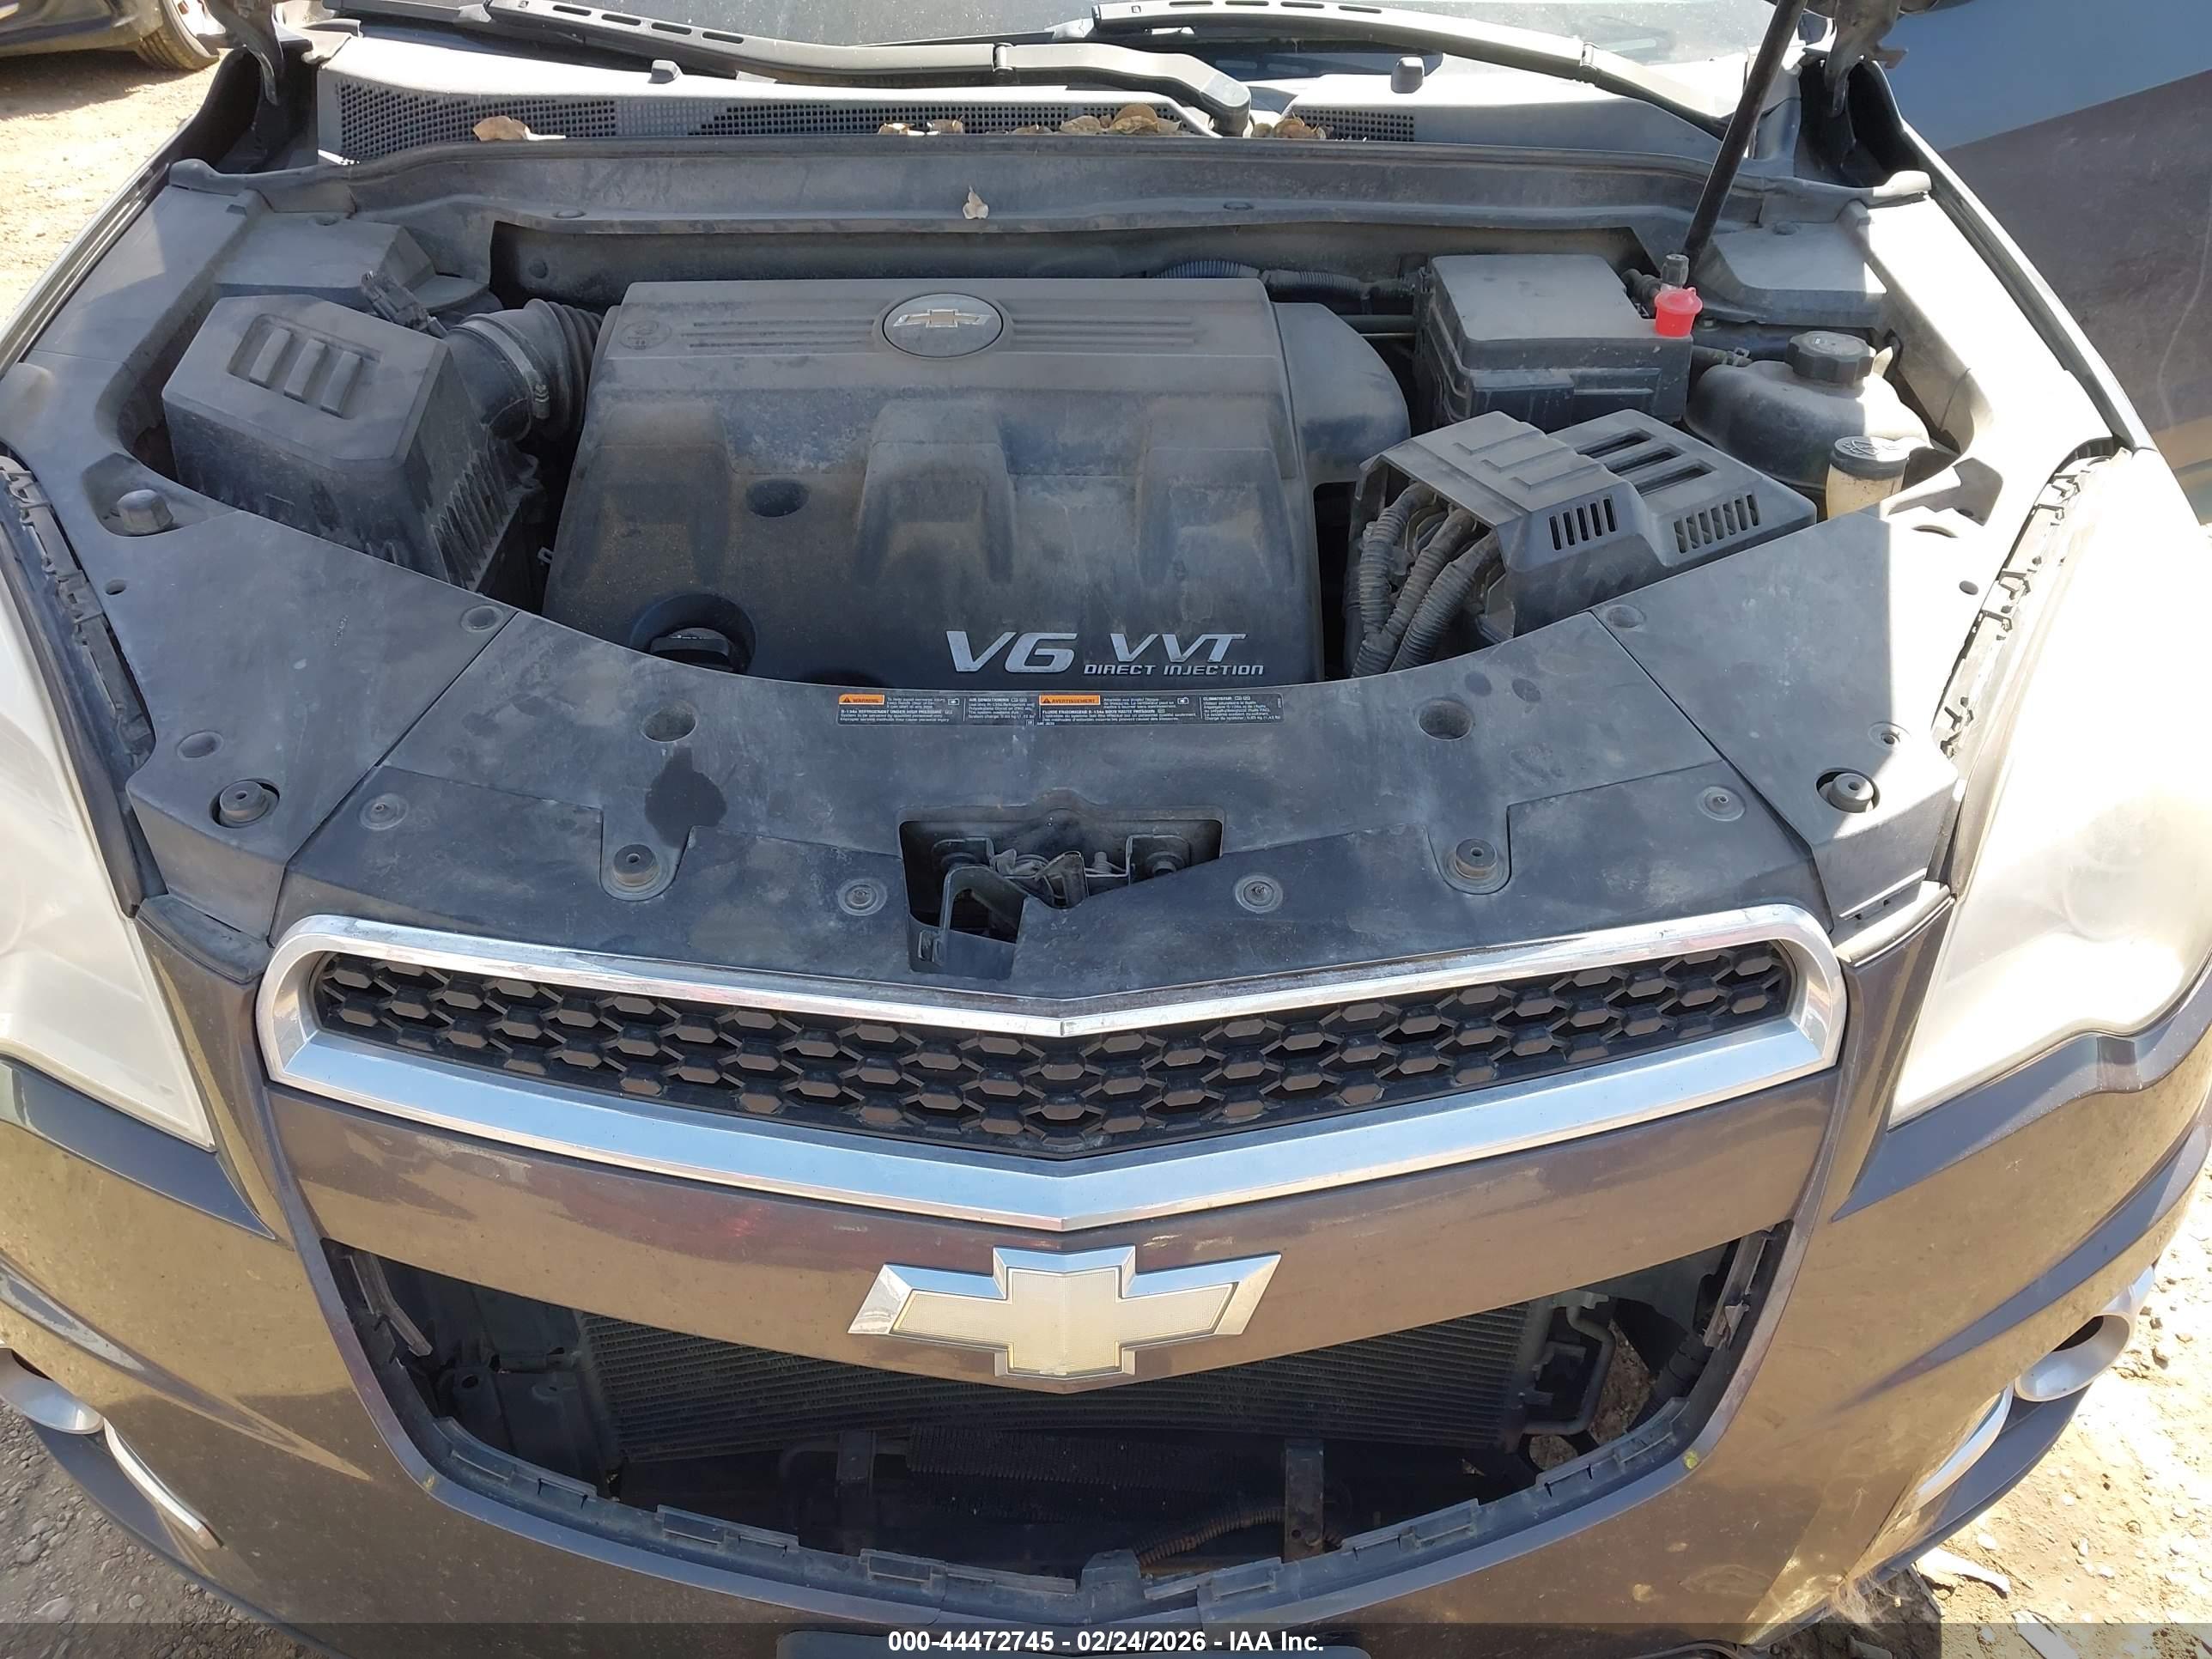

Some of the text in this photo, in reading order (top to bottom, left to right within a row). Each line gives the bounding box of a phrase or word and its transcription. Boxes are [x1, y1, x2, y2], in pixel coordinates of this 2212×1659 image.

[946, 631, 1246, 673] V6 VVT
[1084, 664, 1264, 675] DIRECT INJECTION
